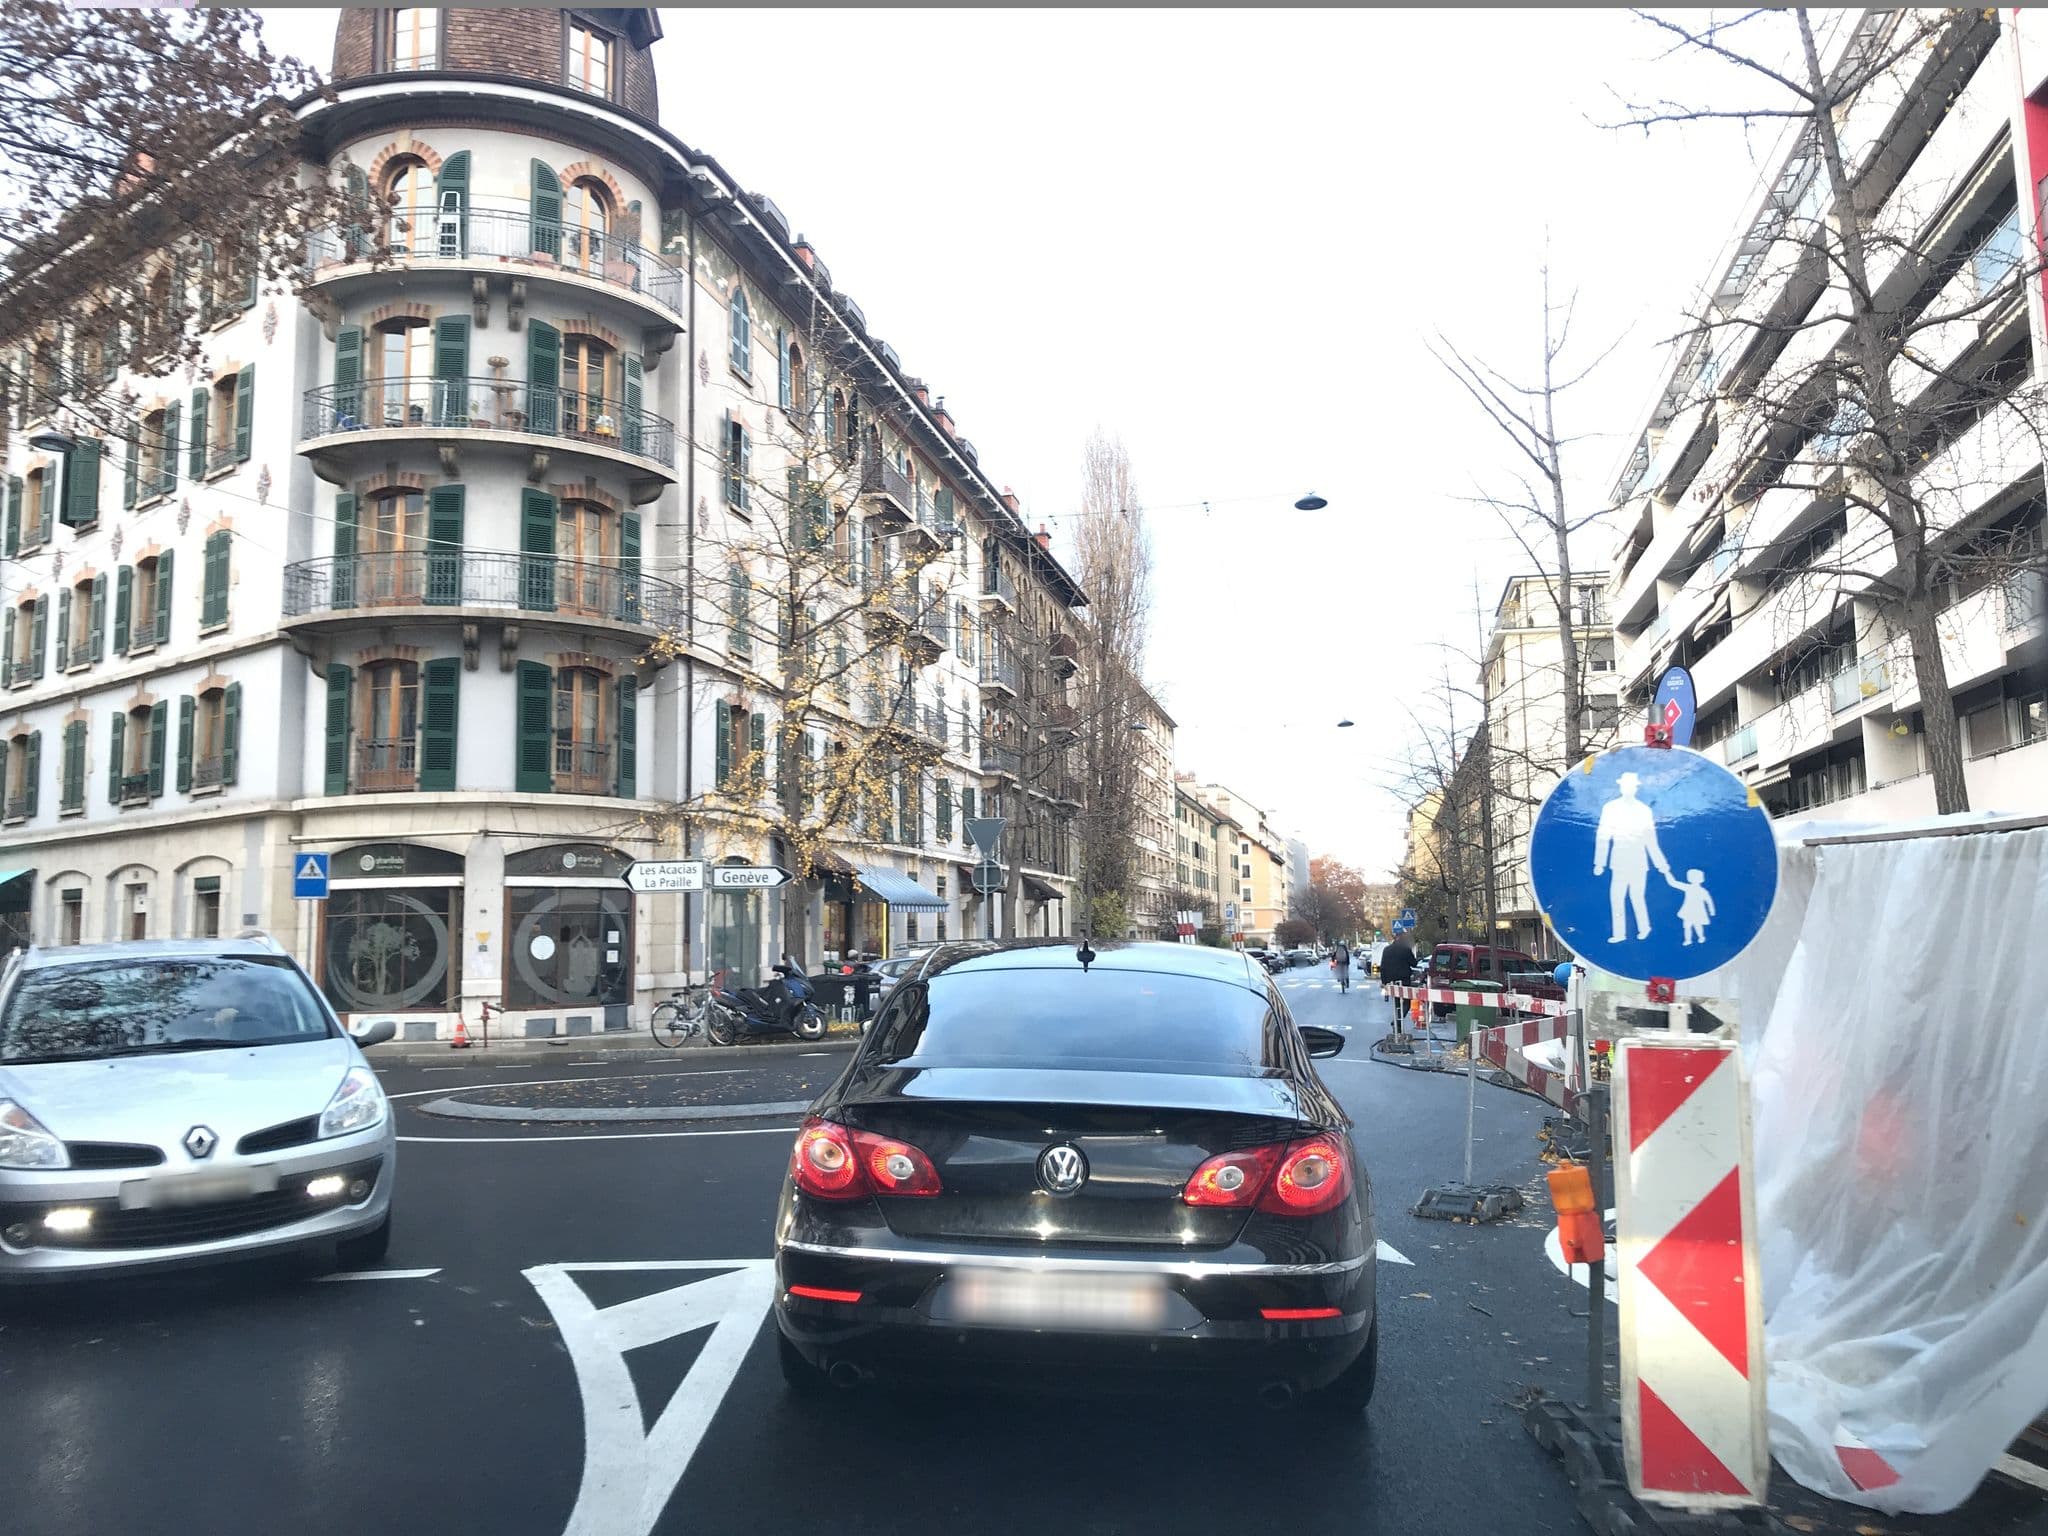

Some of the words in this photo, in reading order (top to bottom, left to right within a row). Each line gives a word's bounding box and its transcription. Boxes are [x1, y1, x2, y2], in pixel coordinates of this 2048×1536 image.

[639, 865, 656, 875] Les
[658, 864, 697, 875] Acacias
[644, 878, 656, 888] La
[659, 877, 692, 888] Praille
[722, 871, 769, 884] Genève
